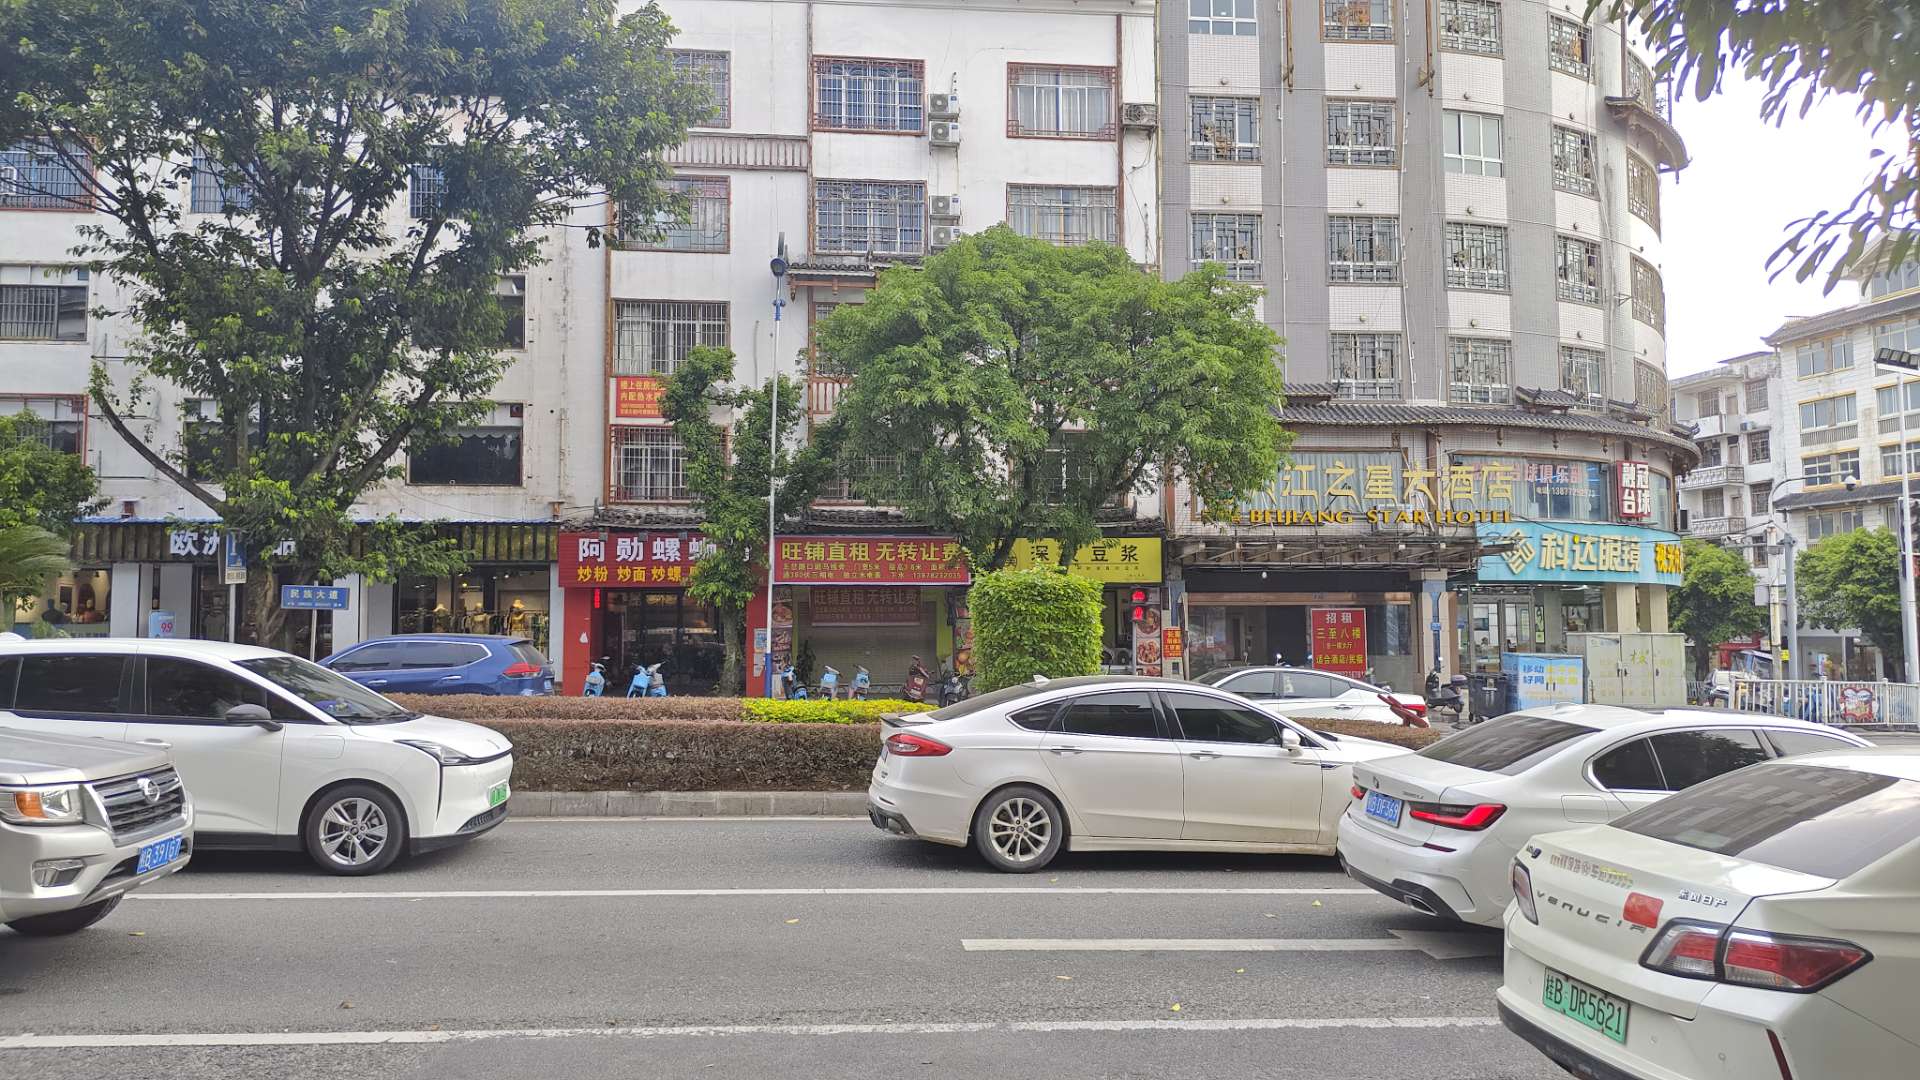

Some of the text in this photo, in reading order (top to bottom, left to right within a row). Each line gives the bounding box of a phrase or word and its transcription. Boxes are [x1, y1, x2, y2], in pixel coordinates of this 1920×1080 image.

[1249, 509, 1353, 525] BEIJIANG
[1366, 509, 1426, 524] STAR
[1435, 508, 1513, 525] HOTEL
[170, 530, 297, 556] 欧洲
[578, 537, 752, 562] 阿勋螺蛳
[781, 541, 962, 562] 旺铺直租 无转让费
[1030, 544, 1138, 562] 深豆浆
[1540, 532, 1641, 574] 科达眼镜
[577, 566, 609, 582] 炒粉
[616, 566, 647, 582] 炒面
[290, 589, 339, 600] 民族大道
[1678, 888, 1728, 908] 东风日产
